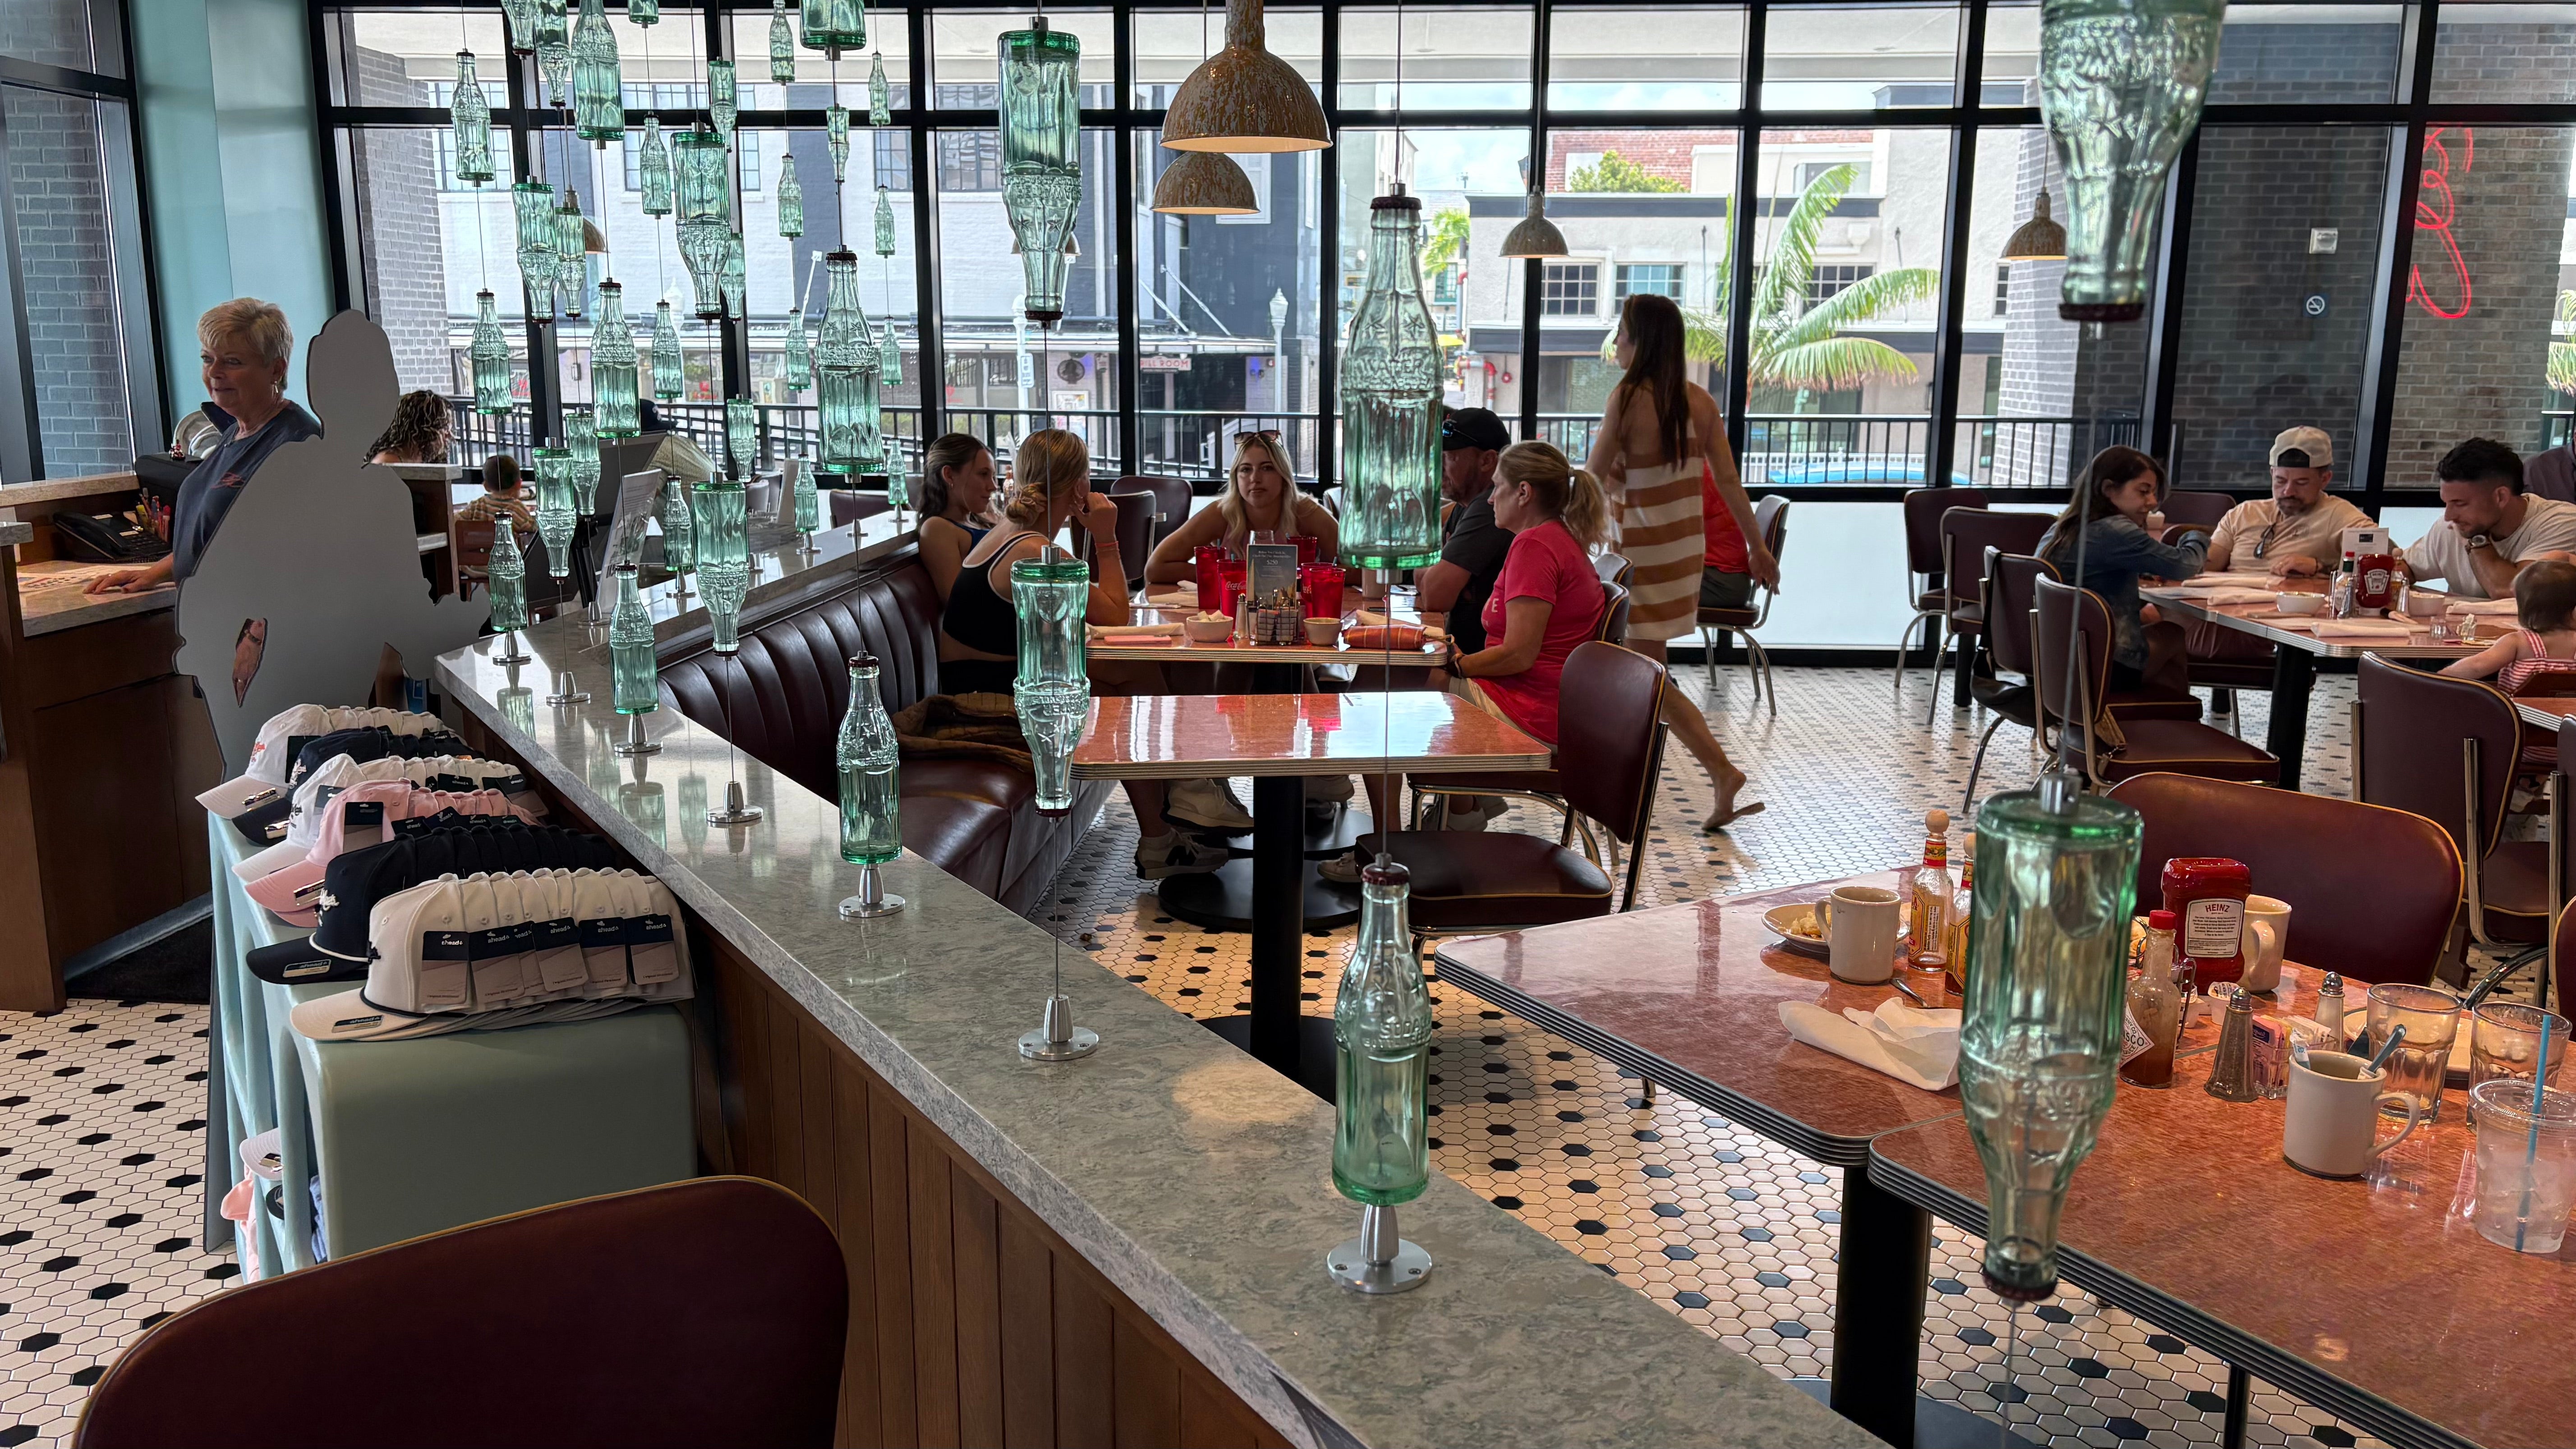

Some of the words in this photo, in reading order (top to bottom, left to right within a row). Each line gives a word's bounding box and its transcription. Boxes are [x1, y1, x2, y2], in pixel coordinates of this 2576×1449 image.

[2205, 903, 2230, 913] HEINZ
[550, 925, 567, 934] ahead
[488, 935, 506, 943] ahead
